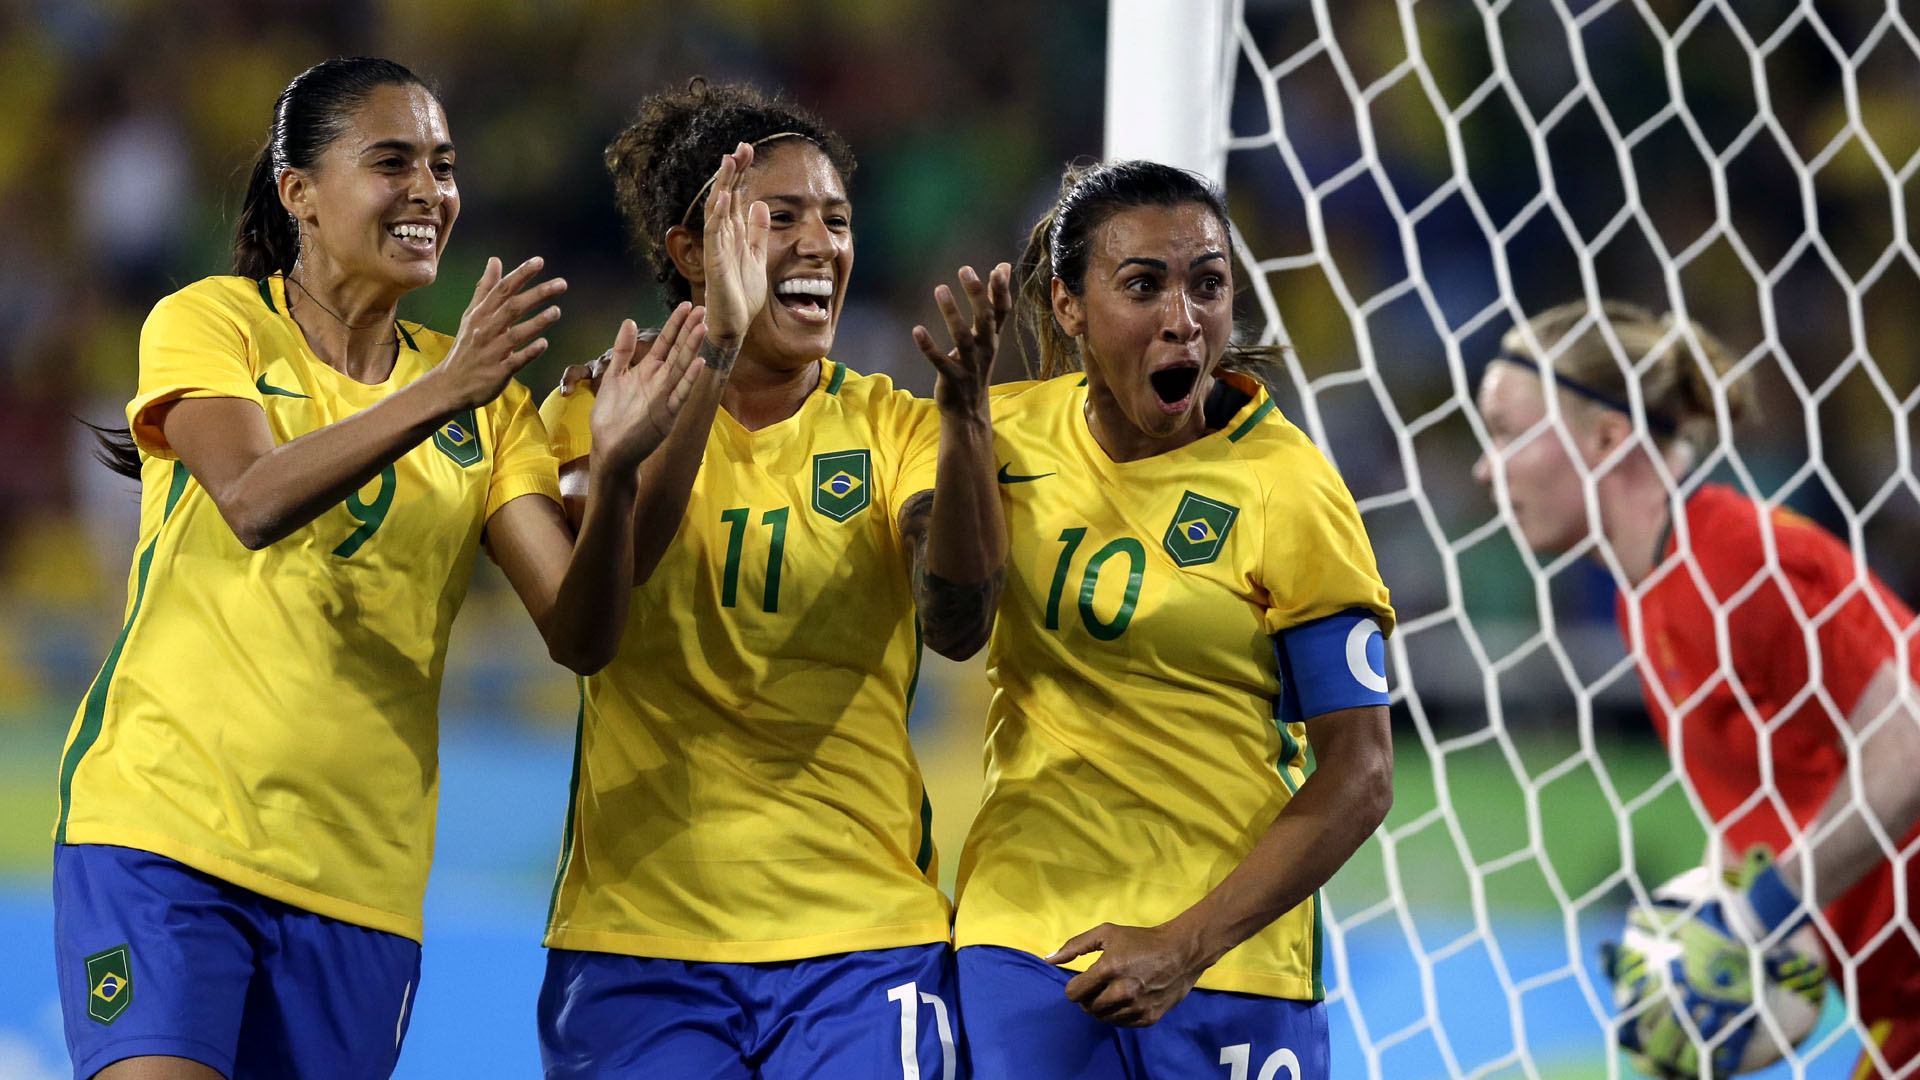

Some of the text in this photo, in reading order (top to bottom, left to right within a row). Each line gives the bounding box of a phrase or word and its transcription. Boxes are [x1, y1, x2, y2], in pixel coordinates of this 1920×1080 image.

[332, 463, 396, 558] 9
[720, 506, 789, 613] 11
[1045, 527, 1146, 641] 10
[887, 981, 957, 1080] 11
